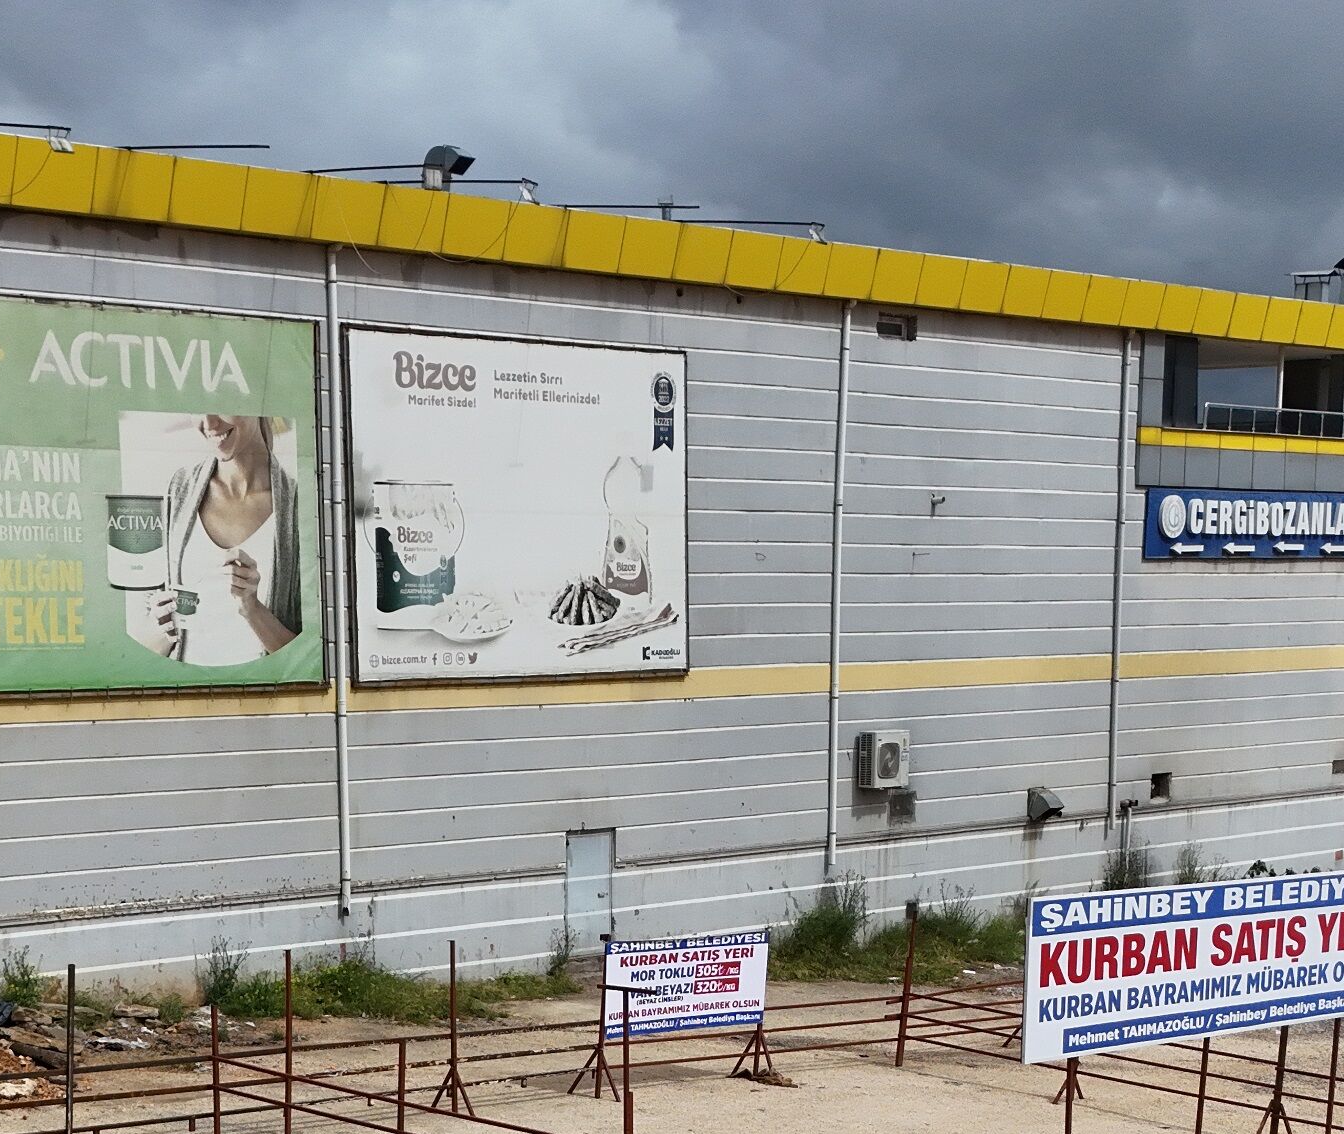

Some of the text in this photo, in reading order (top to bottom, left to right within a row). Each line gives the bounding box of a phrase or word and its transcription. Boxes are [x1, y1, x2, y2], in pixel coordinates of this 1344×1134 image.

[29, 329, 250, 395] ACTIVIA
[393, 350, 476, 392] Bizce
[494, 370, 562, 385] Lezzetin Sırrı
[408, 395, 476, 408] Marifet Sizde!
[494, 388, 600, 404] Marifetli Ellerinizde!
[107, 514, 164, 530] ACTIVIA
[63, 525, 84, 543] İLE
[397, 526, 433, 543] Bizce
[616, 562, 636, 572] Bizce
[382, 656, 428, 665] bizce.com.tr
[1040, 890, 1217, 932] ŞAHİNBEY
[620, 945, 754, 968] KURBAN SATIŞ YERİ
[1040, 927, 1198, 988] KURBAN
[1212, 915, 1306, 966] SATIŞ
[630, 970, 655, 982] MOR
[658, 966, 694, 980] TOKLU
[656, 983, 694, 996] BEYAZI
[1038, 989, 1122, 1022] KURBAN
[1128, 974, 1242, 1010] BAYRAMIMIZ
[1246, 963, 1328, 994] MÜBAREK
[608, 1000, 760, 1020] KURAN BAYRAMIMIZ MÜBAREK OLSUN
[1068, 1028, 1120, 1048] Mehmet
[1122, 1014, 1204, 1040] TAHMAZOĞLU
[1216, 1007, 1267, 1030] Şahinbey
[1269, 1001, 1316, 1022] Belediye
